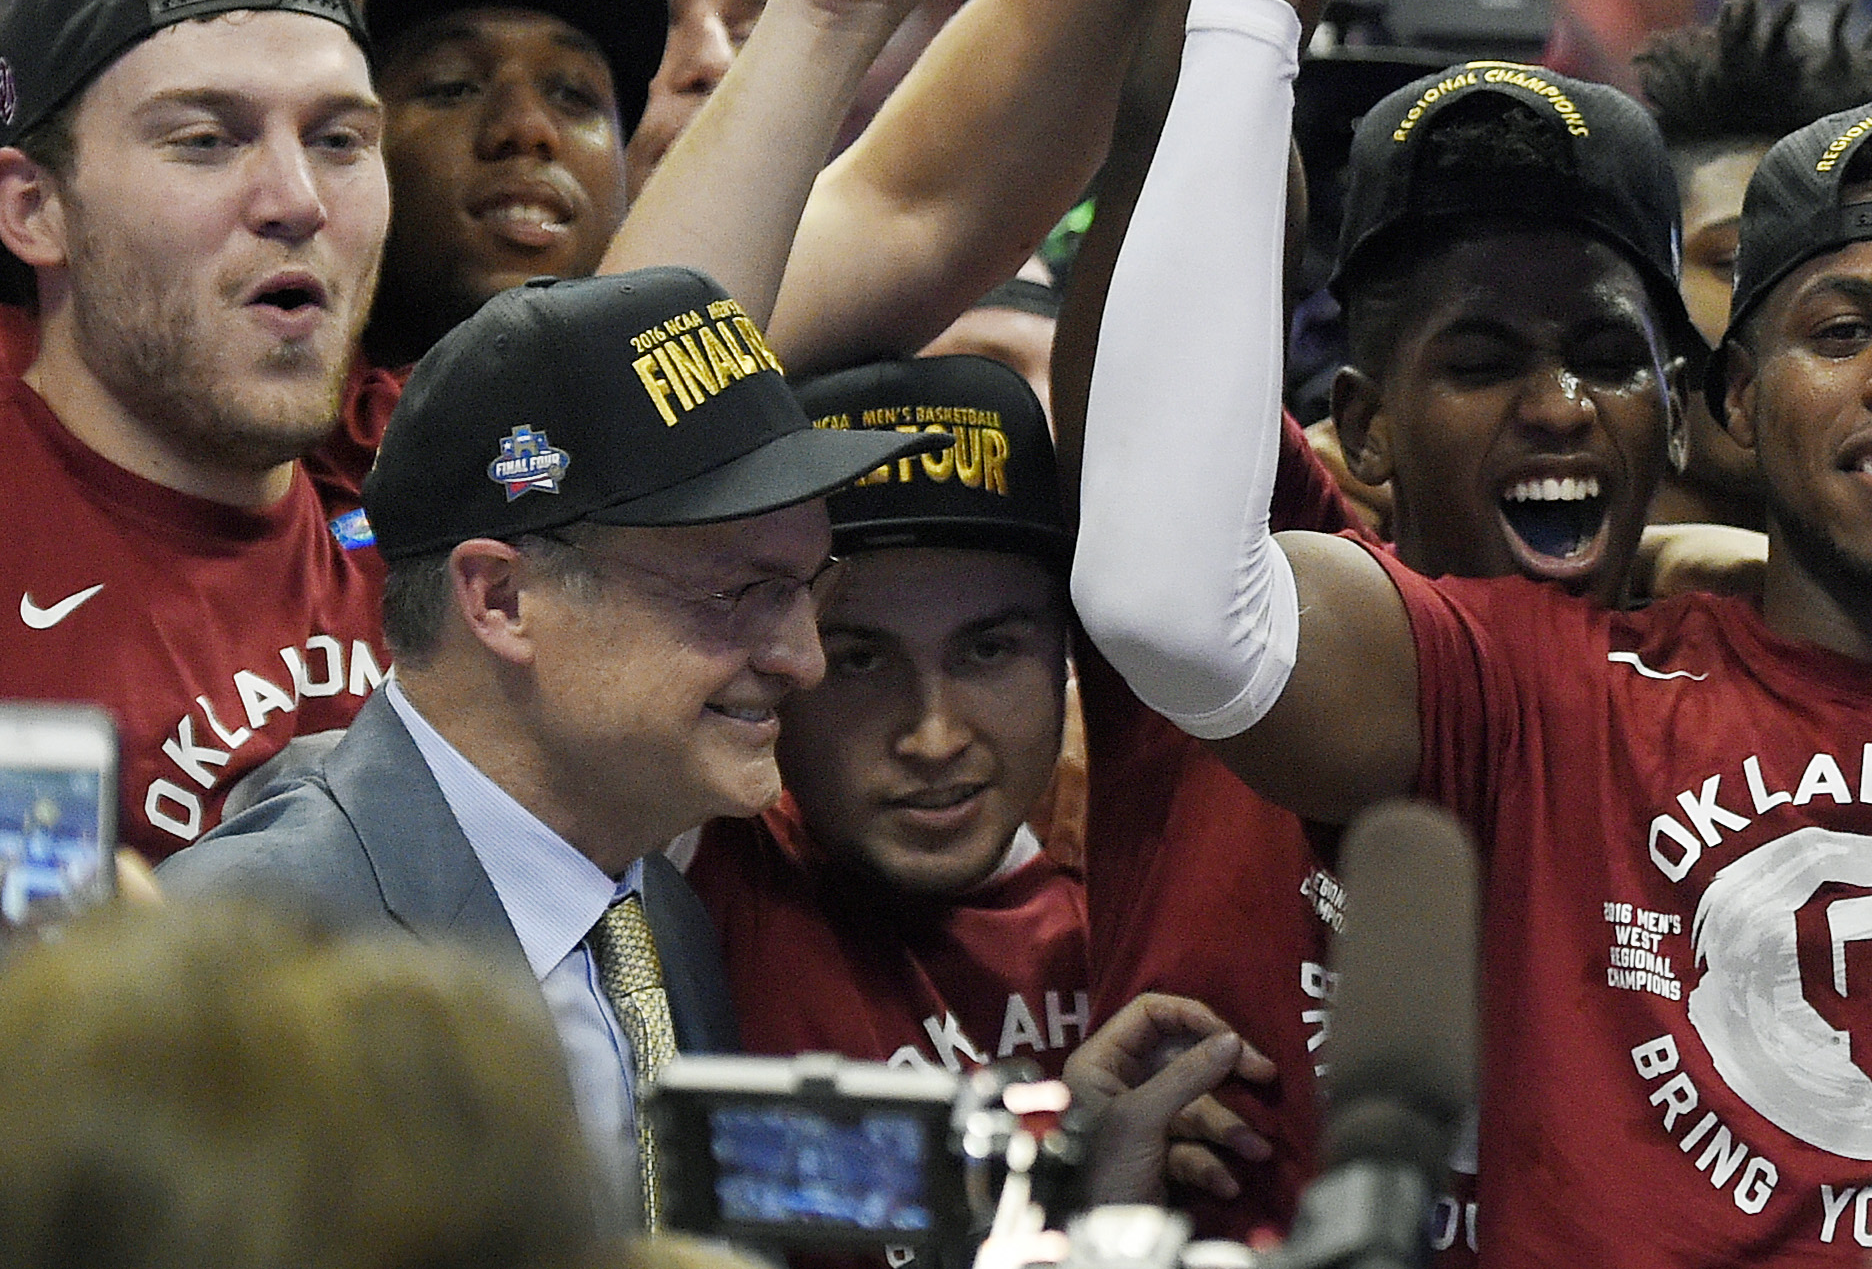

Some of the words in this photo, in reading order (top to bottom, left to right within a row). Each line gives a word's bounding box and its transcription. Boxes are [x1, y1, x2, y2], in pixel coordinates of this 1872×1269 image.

[1393, 72, 1478, 141] REGIONAL
[1484, 69, 1590, 137] CHAMPIONS
[630, 327, 667, 353] 2016
[663, 310, 704, 336] NCAA
[632, 321, 758, 427] FINAL
[862, 407, 911, 427] MEN'S
[916, 406, 1000, 428] BASKETBALL
[496, 458, 528, 477] FINAL
[1637, 907, 1682, 935] MEN'S
[1615, 925, 1663, 954] WEST
[1610, 946, 1676, 979] REGIONAL
[1607, 966, 1682, 1001] CHAMPIONS
[1631, 1034, 1779, 1215] BRING
